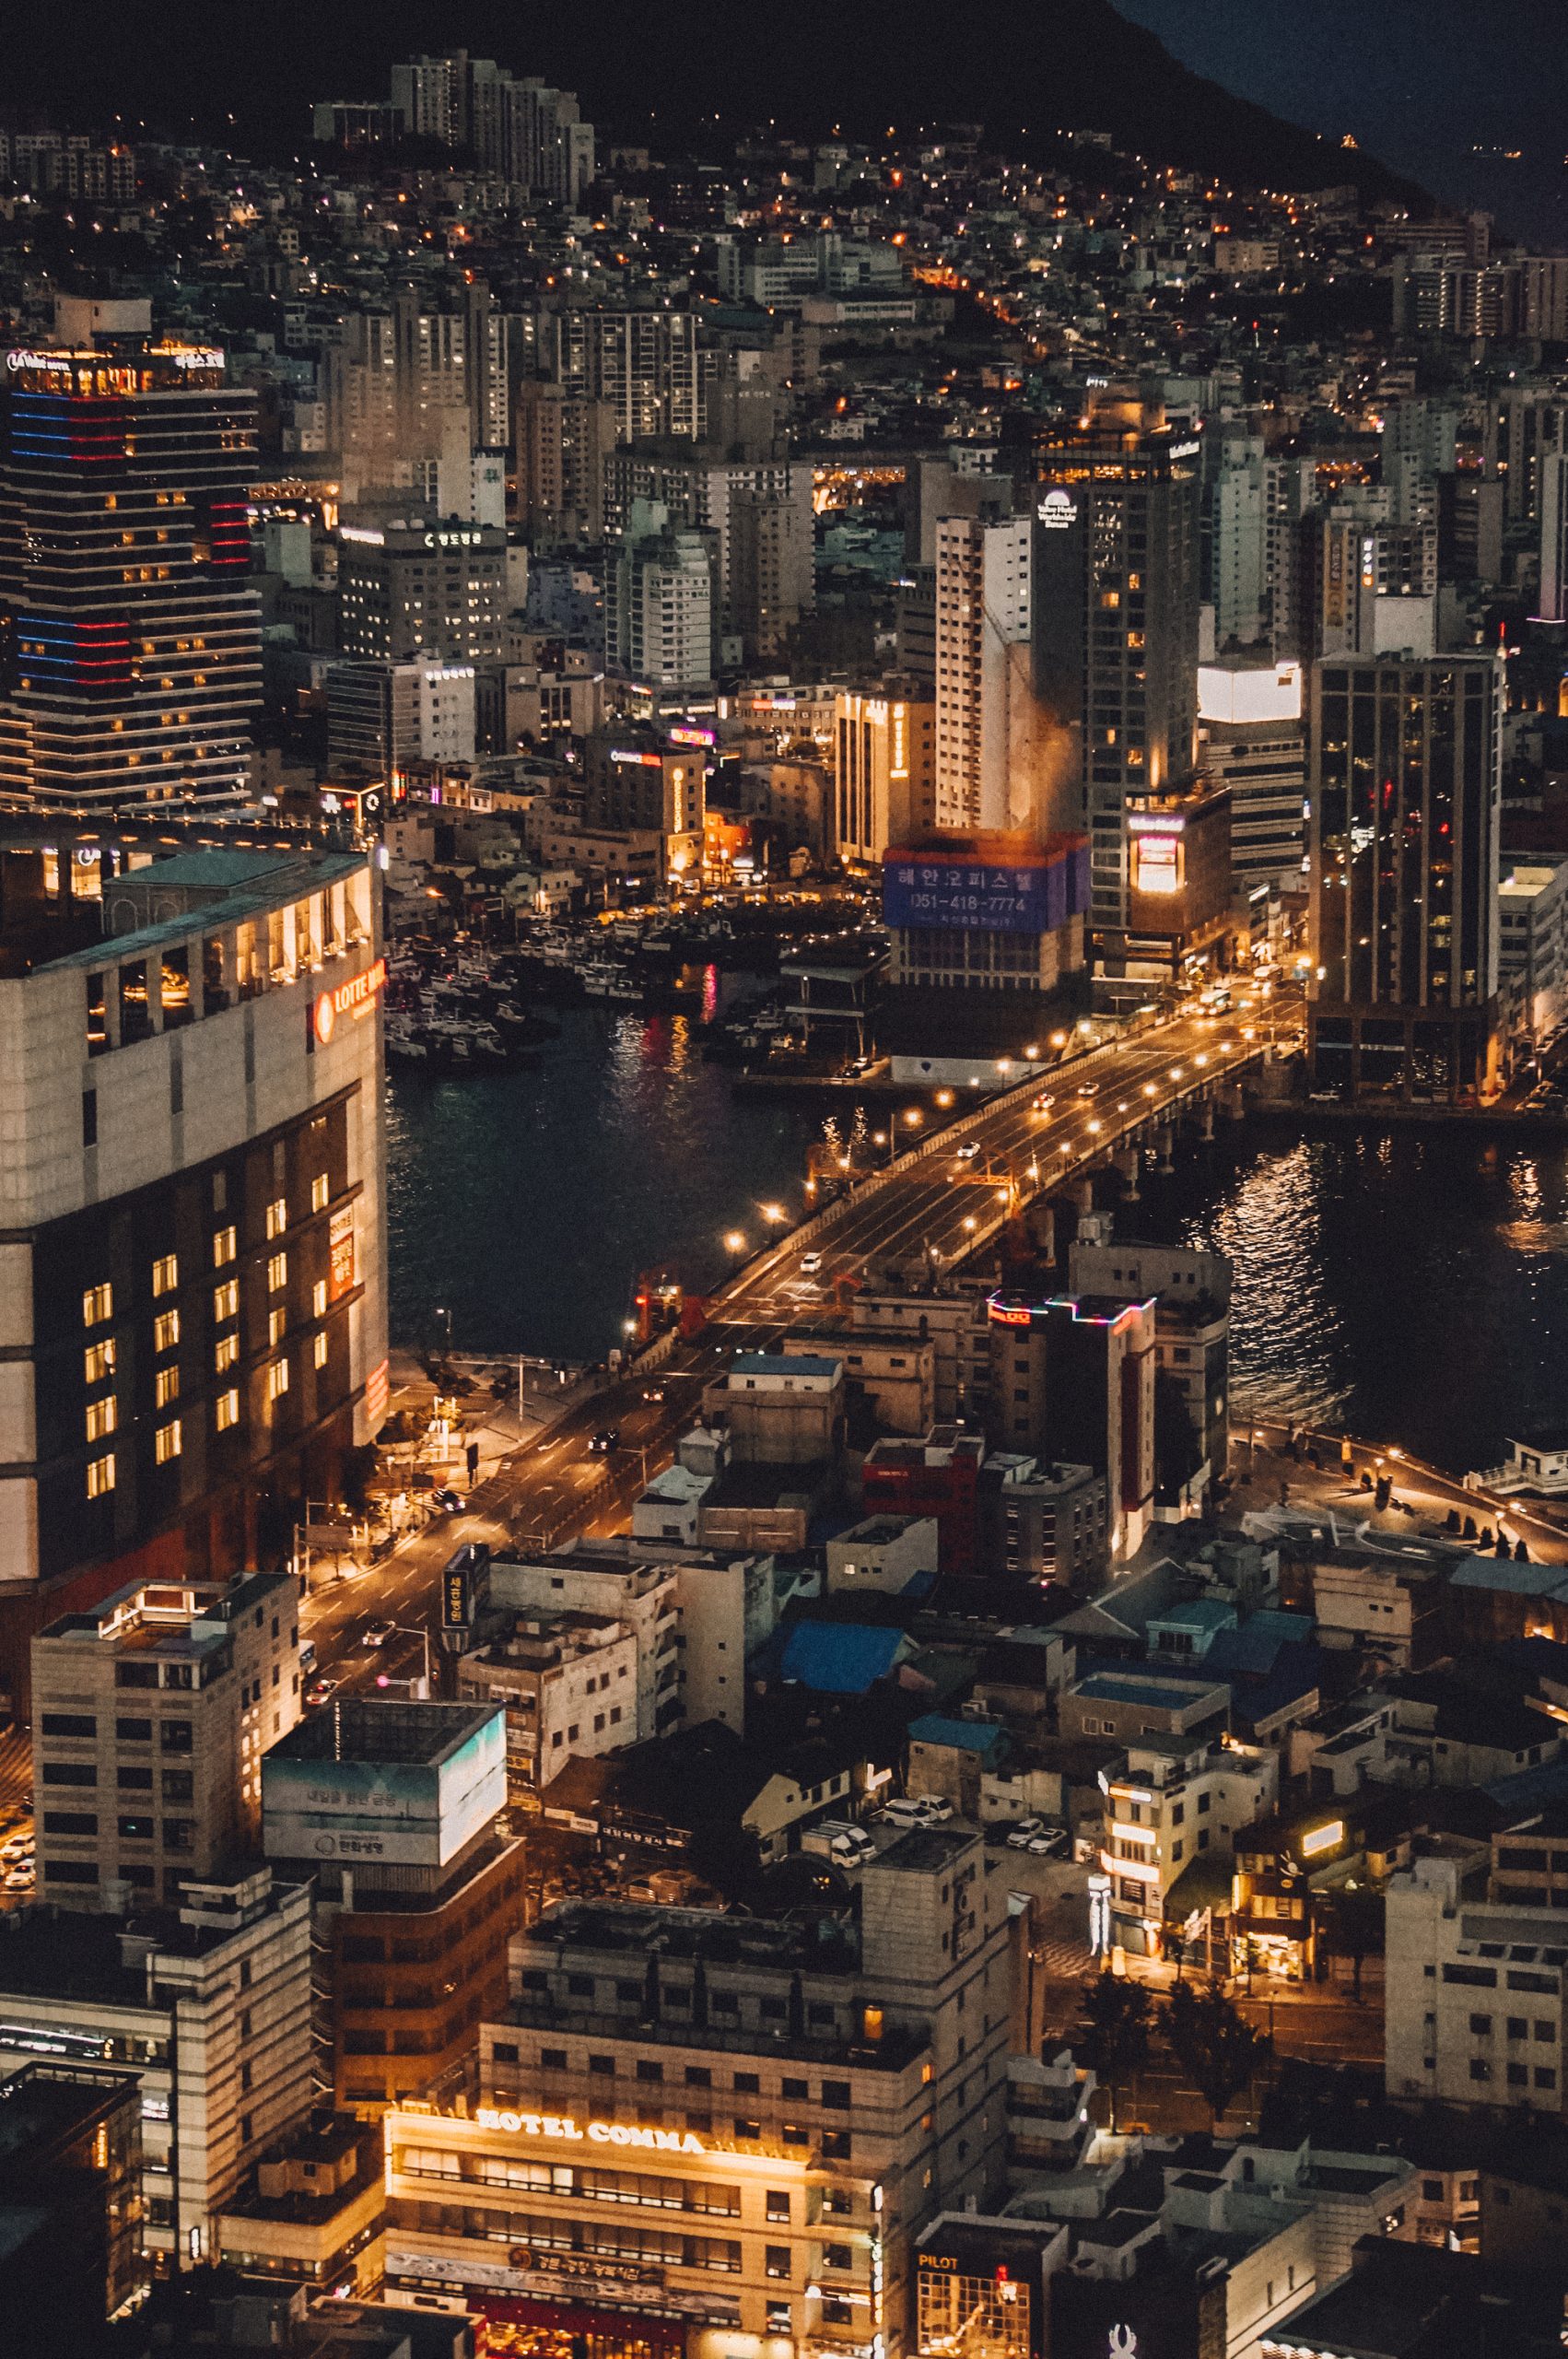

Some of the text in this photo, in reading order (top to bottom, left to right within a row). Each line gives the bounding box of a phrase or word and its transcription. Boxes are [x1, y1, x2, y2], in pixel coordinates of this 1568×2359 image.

[911, 894, 1026, 910] 051-418-7774
[334, 974, 368, 1013] LOTTE
[476, 2108, 706, 2154] HOTEL COMMA
[919, 2254, 958, 2270] PILOT
